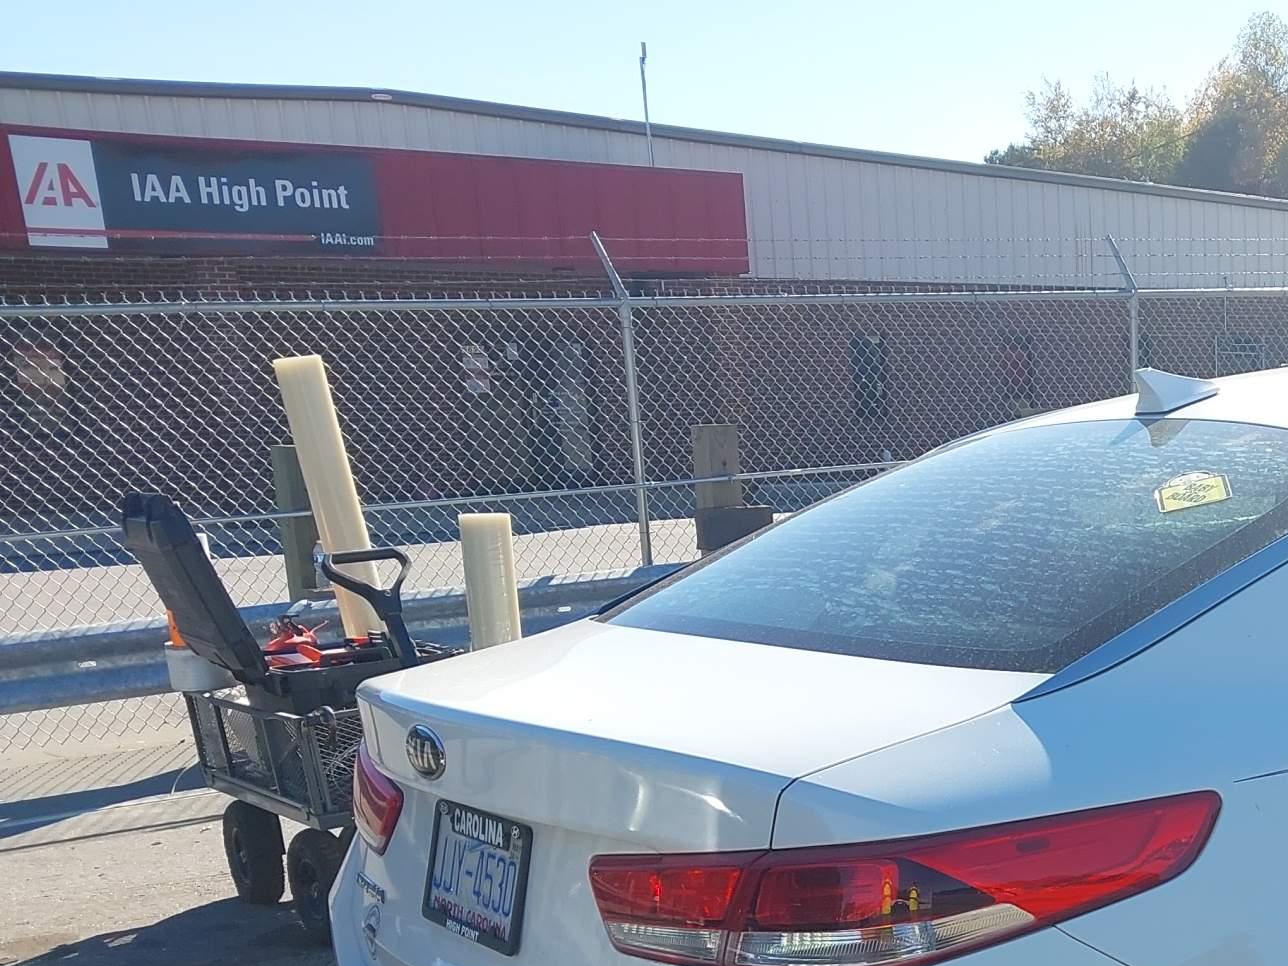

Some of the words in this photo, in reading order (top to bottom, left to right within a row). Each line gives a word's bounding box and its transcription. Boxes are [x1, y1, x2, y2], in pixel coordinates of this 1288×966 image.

[130, 173, 191, 203] IAA
[198, 176, 267, 212] High
[275, 180, 350, 209] Point
[407, 735, 437, 770] KIA
[453, 808, 504, 848] CAROLINA
[432, 836, 517, 918] JJY-4530
